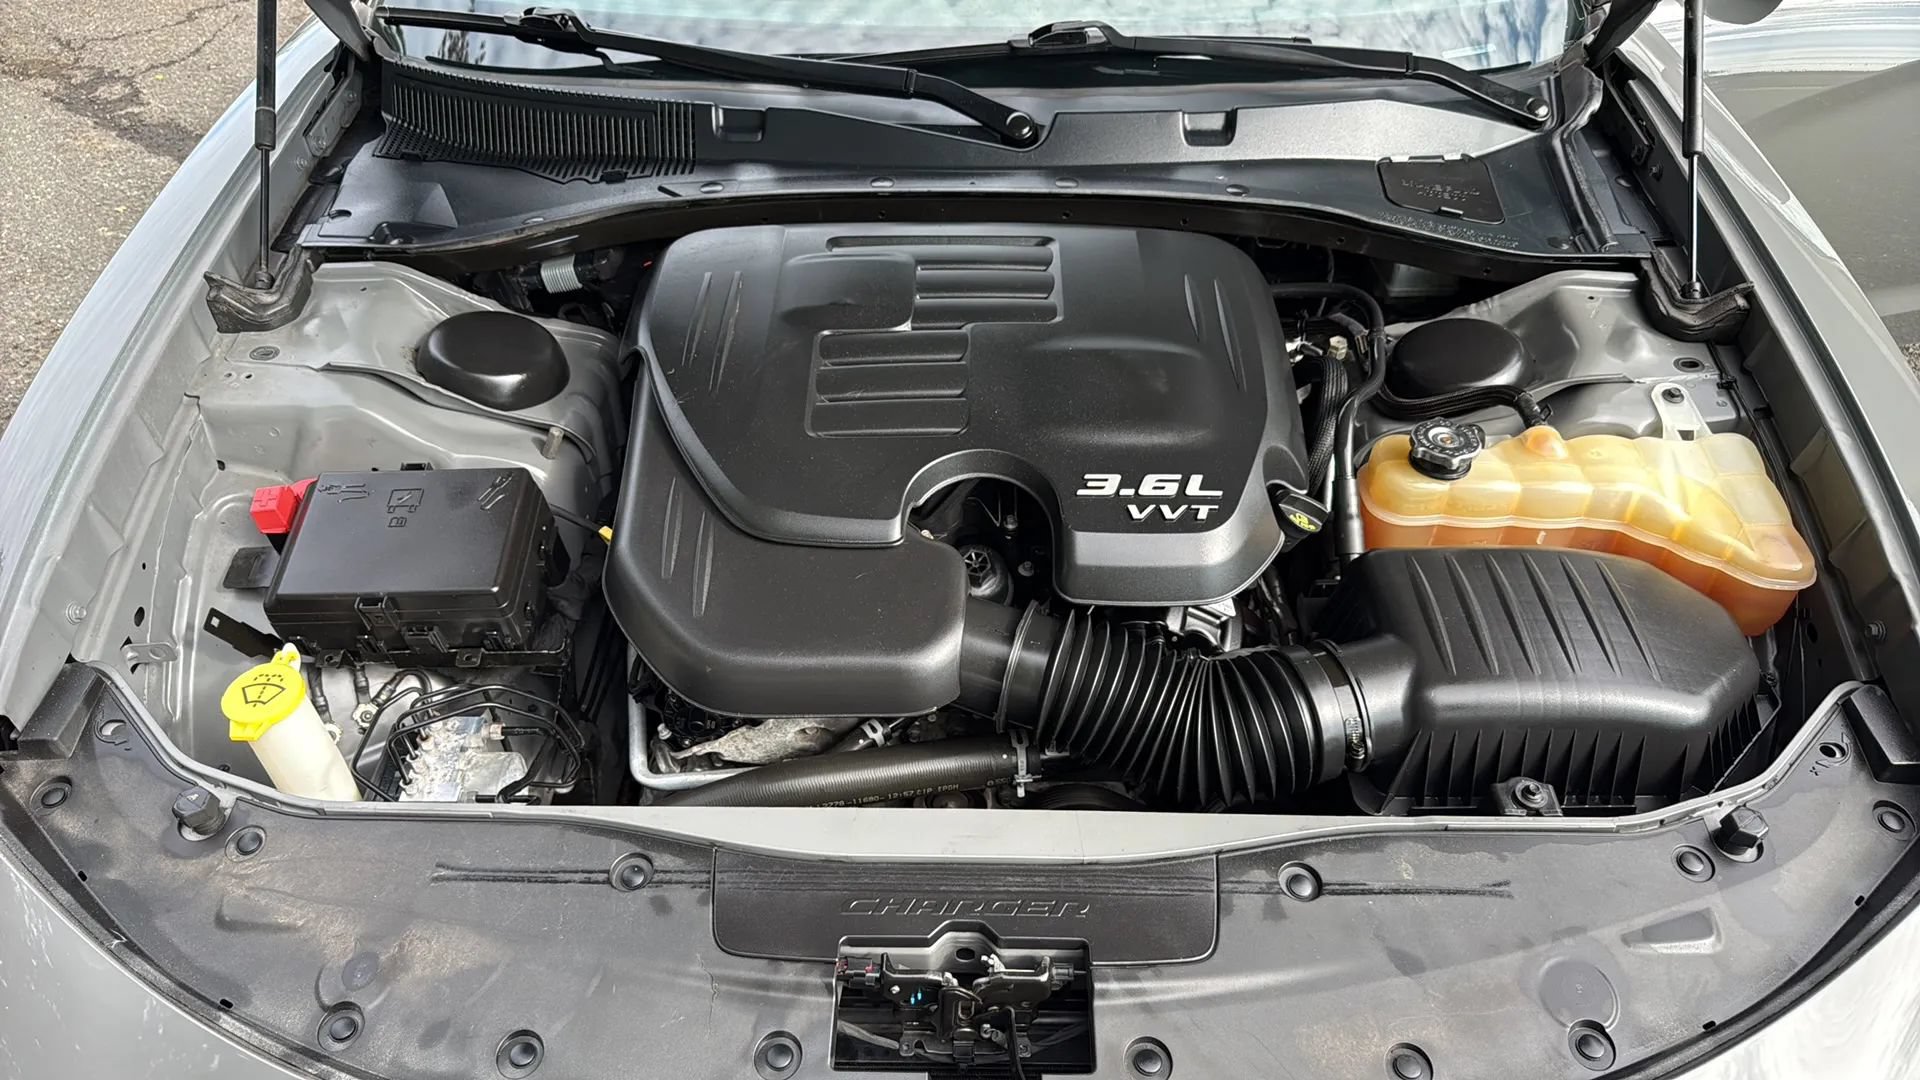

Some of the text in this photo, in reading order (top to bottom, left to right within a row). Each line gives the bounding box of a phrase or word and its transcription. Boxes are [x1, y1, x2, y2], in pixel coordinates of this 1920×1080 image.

[1076, 473, 1223, 497] 3.6L
[1126, 504, 1219, 521] VVT
[841, 898, 1090, 917] CHARGER
